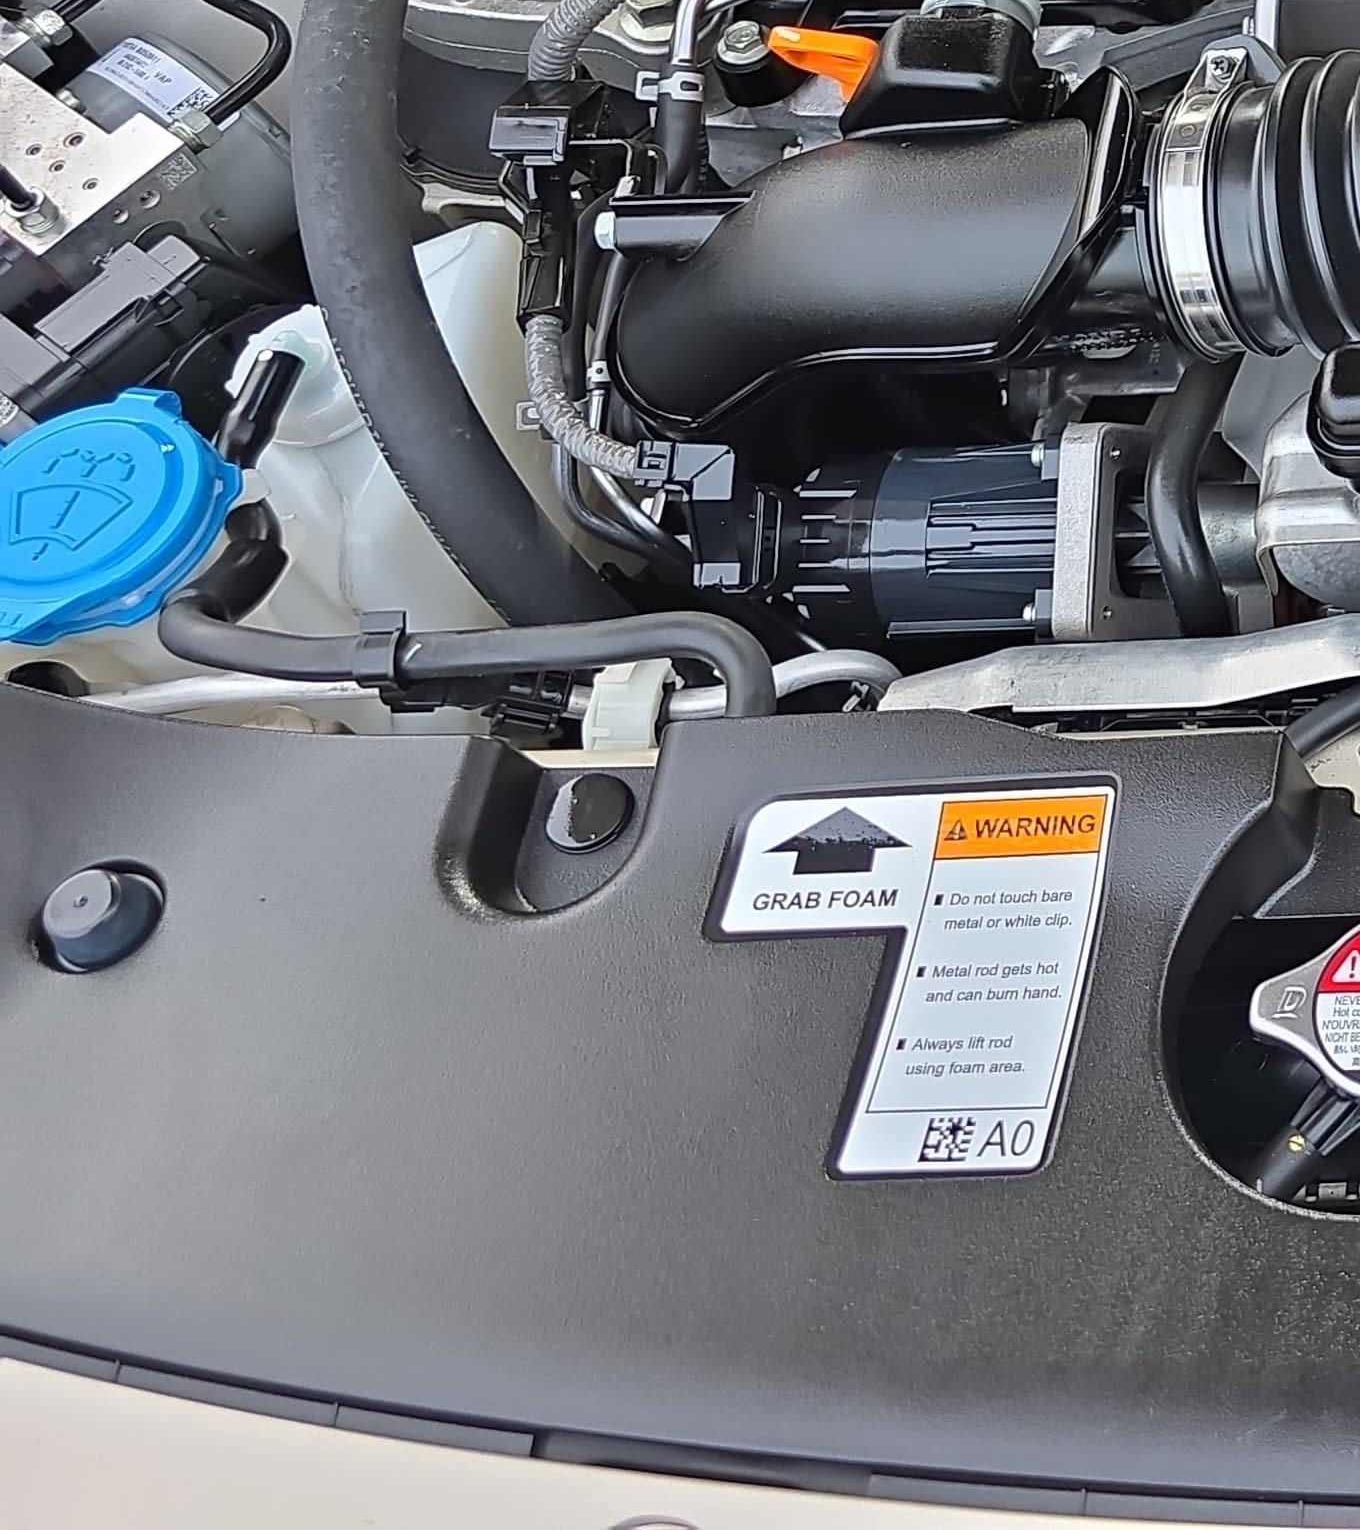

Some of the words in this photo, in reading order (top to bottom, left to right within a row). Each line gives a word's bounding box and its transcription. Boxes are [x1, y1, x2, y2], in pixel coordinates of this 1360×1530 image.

[975, 814, 1096, 840] WARNING
[752, 890, 821, 911] GRAB
[828, 888, 900, 909] FOAM
[949, 892, 969, 907] Do
[973, 892, 997, 906] not
[999, 891, 1039, 905] touch
[1041, 889, 1073, 903] bare
[944, 914, 983, 930] metal
[986, 917, 1001, 929] or
[1004, 914, 1041, 928] white
[1045, 913, 1073, 930] clip.
[932, 964, 971, 979] Metal
[975, 963, 999, 977] rod
[1001, 963, 1033, 980] gets
[1036, 962, 1059, 976] hot
[925, 988, 953, 1002] and
[956, 990, 983, 1002] can
[986, 987, 1019, 1001] burn
[1021, 986, 1062, 1000] hand.
[1333, 1006, 1353, 1017] Hot
[912, 1035, 965, 1052] Always
[967, 1035, 985, 1050] lift
[989, 1035, 1013, 1049] rod
[1325, 1032, 1350, 1043] NICHT
[905, 1060, 945, 1077] using
[949, 1060, 986, 1075] foam
[989, 1060, 1027, 1074] area.
[976, 1119, 1035, 1158] A0
